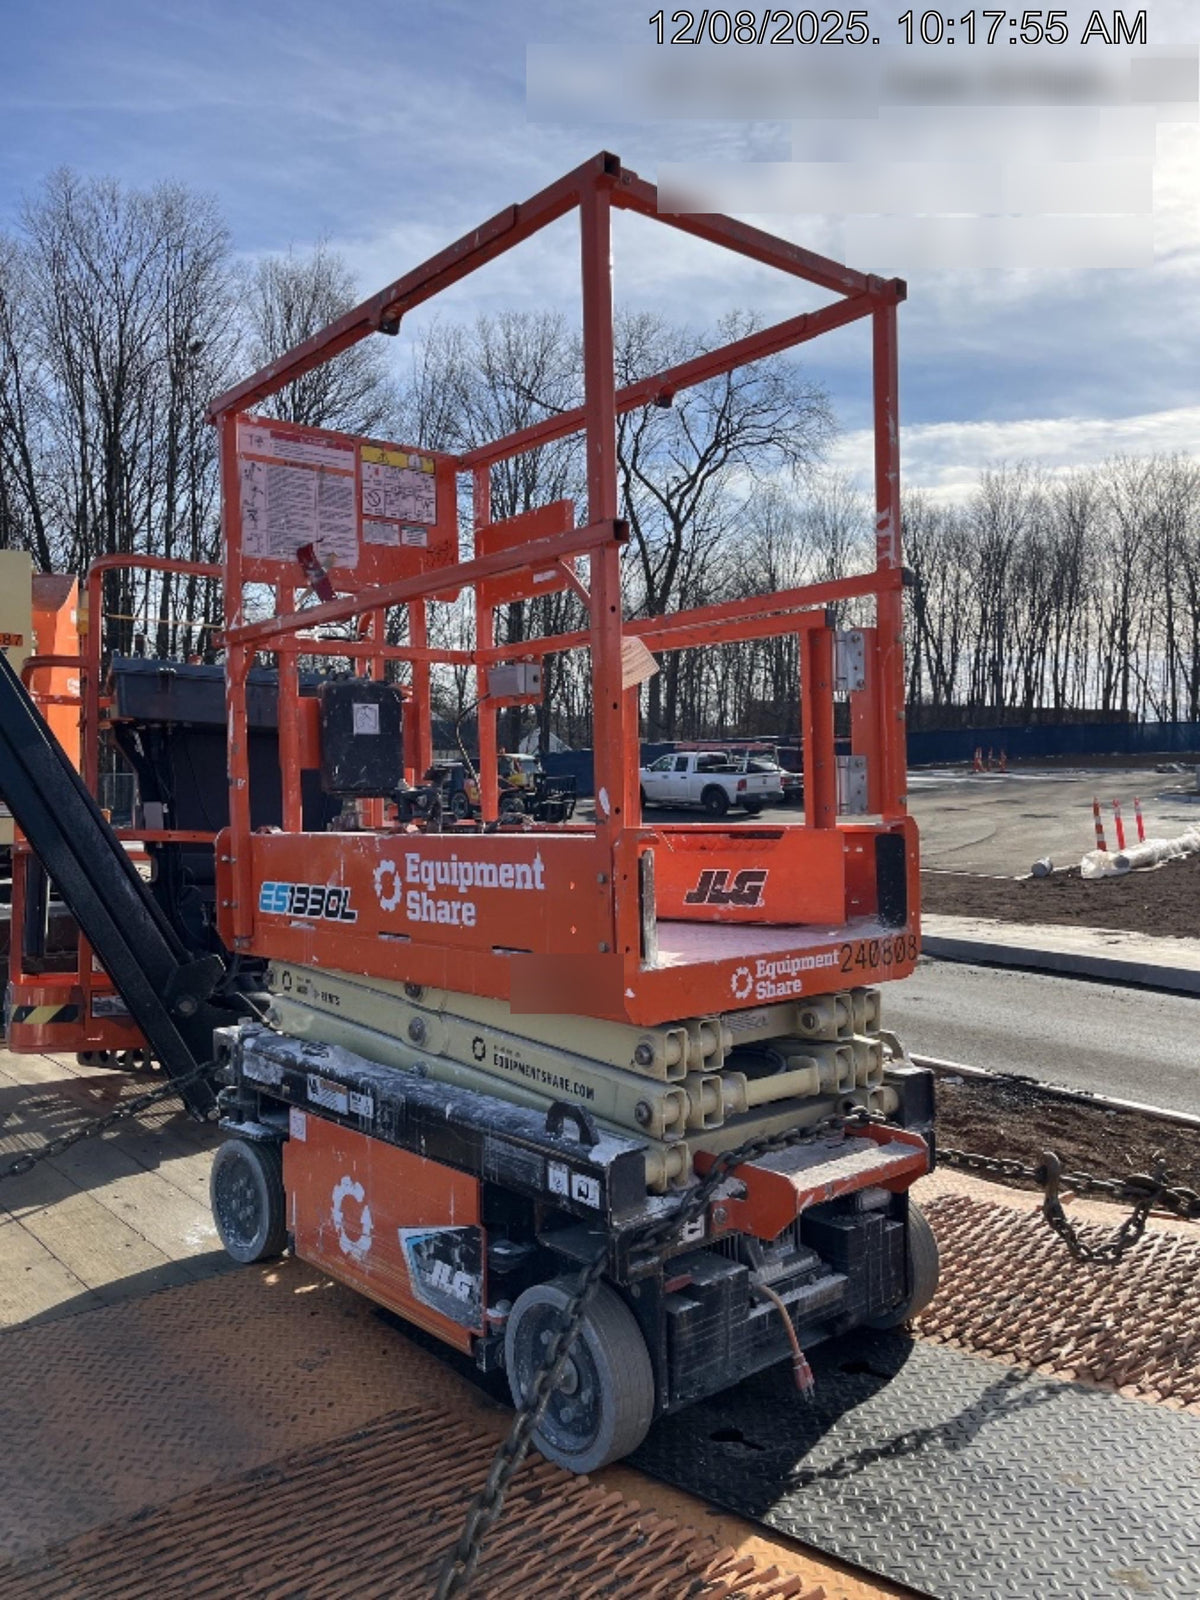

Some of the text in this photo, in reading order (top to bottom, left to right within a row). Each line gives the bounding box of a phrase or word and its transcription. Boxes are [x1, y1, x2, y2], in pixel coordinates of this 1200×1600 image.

[405, 850, 545, 893] Equipment
[683, 868, 769, 907] JLG
[259, 881, 358, 923] ES1330L
[406, 890, 477, 927] Share
[755, 949, 840, 978] Equipment
[840, 934, 917, 973] 240808
[755, 979, 802, 1000] Share
[493, 1053, 595, 1101] EQUIPMENTSHARE.COM
